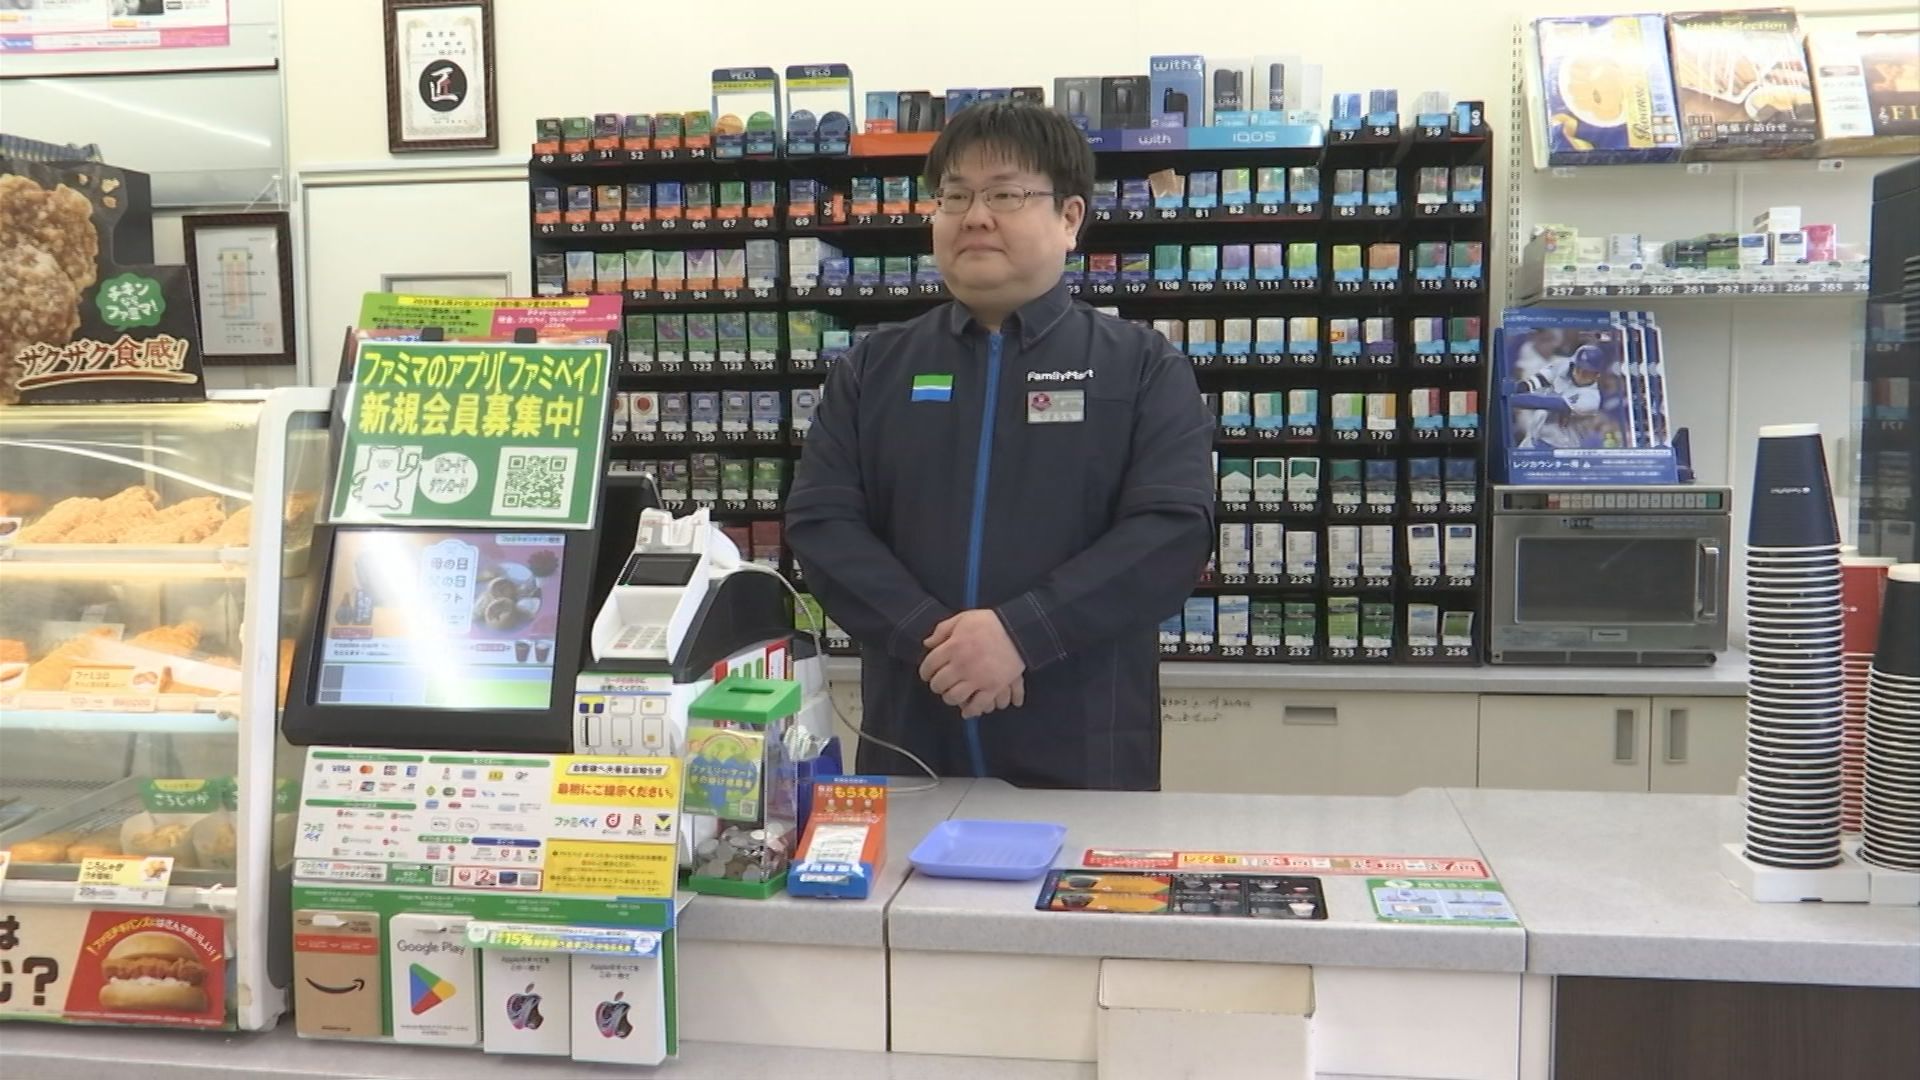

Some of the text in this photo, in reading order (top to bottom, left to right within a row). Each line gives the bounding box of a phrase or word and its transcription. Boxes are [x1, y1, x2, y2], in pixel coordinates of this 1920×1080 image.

[430, 67, 459, 102] 匠
[1472, 110, 1481, 126] 60
[1341, 130, 1354, 139] 57
[1375, 127, 1389, 136] 58
[1427, 128, 1441, 137] 59
[1138, 134, 1172, 145] with
[1233, 131, 1276, 143] IQOS
[571, 153, 583, 162] 50
[631, 151, 643, 160] 52
[662, 150, 674, 159] 53
[692, 149, 704, 158] 54
[541, 154, 553, 163] 49
[1196, 208, 1208, 217] 81
[1230, 205, 1243, 214] 82
[1264, 205, 1277, 214] 83
[1298, 204, 1311, 213] 84
[1341, 207, 1355, 216] 85
[1375, 206, 1390, 215] 86
[1425, 204, 1439, 213] 87
[1097, 211, 1109, 220] 78
[1130, 210, 1143, 219] 79
[796, 217, 809, 226] 69
[859, 215, 870, 224] 71
[891, 215, 903, 224] 72
[542, 224, 554, 233] 61
[572, 223, 584, 232] 62
[602, 223, 614, 232] 63
[662, 220, 675, 229] 65
[723, 220, 736, 229] 67
[1094, 284, 1113, 293] 106
[1126, 284, 1145, 293] 107
[1160, 281, 1179, 290] 108
[1193, 282, 1212, 291] 109
[1260, 280, 1280, 289] 111
[1293, 280, 1313, 289] 112
[1339, 282, 1359, 291] 113
[1374, 282, 1394, 291] 114
[1421, 280, 1441, 289] 115
[1455, 280, 1476, 289] 116
[1684, 284, 1704, 293] 261
[1787, 283, 1808, 292] 264
[1820, 283, 1842, 292] 265
[633, 290, 646, 299] 92
[725, 289, 737, 298] 95
[755, 288, 768, 297] 96
[829, 287, 841, 296] 98
[860, 287, 873, 296] 99
[889, 286, 908, 295] 100
[1552, 287, 1573, 296] 257
[1585, 286, 1606, 295] 258
[1618, 286, 1640, 295] 259
[664, 291, 676, 300] 93
[16, 333, 189, 376] ザクザク食感!
[1227, 354, 1246, 363] 138
[1260, 354, 1280, 363] 139
[1455, 354, 1476, 363] 144
[1193, 356, 1212, 365] 137
[1337, 356, 1356, 365] 141
[1371, 356, 1391, 365] 142
[1421, 355, 1441, 364] 143
[633, 363, 651, 372] 120
[663, 362, 679, 371] 121
[694, 362, 711, 371] 122
[725, 361, 742, 370] 123
[755, 361, 773, 370] 124
[795, 360, 813, 369] 125
[363, 350, 602, 395] ファミマのアプリ【ファミペイ】
[1027, 369, 1094, 382] FamilyMart
[358, 391, 584, 437] 新規会員募集中!
[727, 431, 744, 440] 151
[757, 431, 775, 440] 152
[1226, 427, 1246, 436] 166
[1338, 431, 1358, 440] 169
[1372, 431, 1392, 440] 170
[1420, 430, 1438, 439] 171
[1454, 428, 1474, 437] 172
[612, 432, 623, 441] 47
[636, 432, 654, 441] 148
[665, 432, 683, 441] 149
[696, 432, 715, 441] 150
[665, 500, 683, 509] 177
[727, 501, 745, 510] 179
[1227, 502, 1246, 511] 194
[1260, 502, 1279, 511] 195
[1337, 504, 1357, 513] 197
[1416, 504, 1437, 513] 199
[1225, 574, 1245, 583] 222
[1258, 575, 1278, 584] 223
[1334, 578, 1354, 587] 225
[1368, 577, 1389, 586] 226
[1416, 576, 1436, 585] 227
[1450, 577, 1471, 586] 228
[1190, 644, 1210, 653] 249
[1289, 647, 1309, 656] 252
[1333, 648, 1353, 657] 253
[1367, 648, 1387, 657] 254
[1447, 647, 1468, 656] 256
[554, 816, 598, 828] ファミペイ
[397, 940, 465, 960] Google Play
